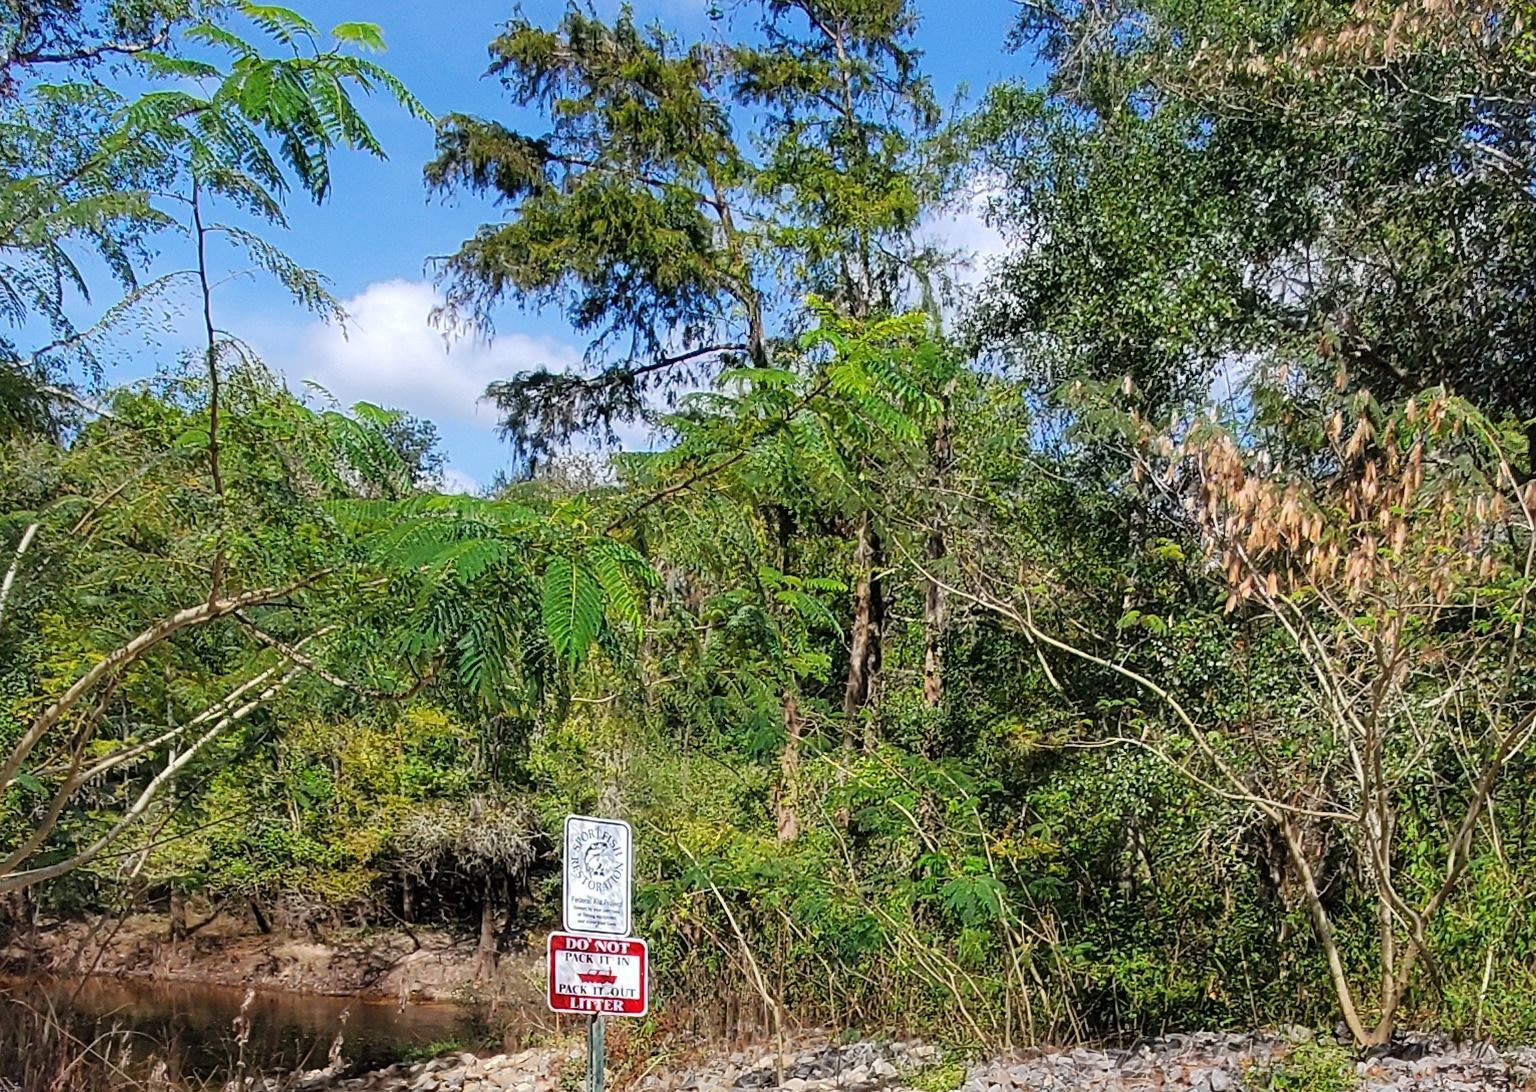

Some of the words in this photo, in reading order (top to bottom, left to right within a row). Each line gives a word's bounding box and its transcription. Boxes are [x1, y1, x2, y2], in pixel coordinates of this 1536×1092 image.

[571, 857, 624, 894] RESTORATION
[565, 937, 590, 951] DO
[594, 940, 630, 954] NOT
[565, 952, 593, 964] PACK
[599, 955, 610, 965] IT
[617, 957, 630, 966] IN
[559, 983, 587, 995] PACK
[593, 986, 604, 996] IT
[610, 987, 636, 998] OUT
[570, 997, 624, 1012] LITTER
